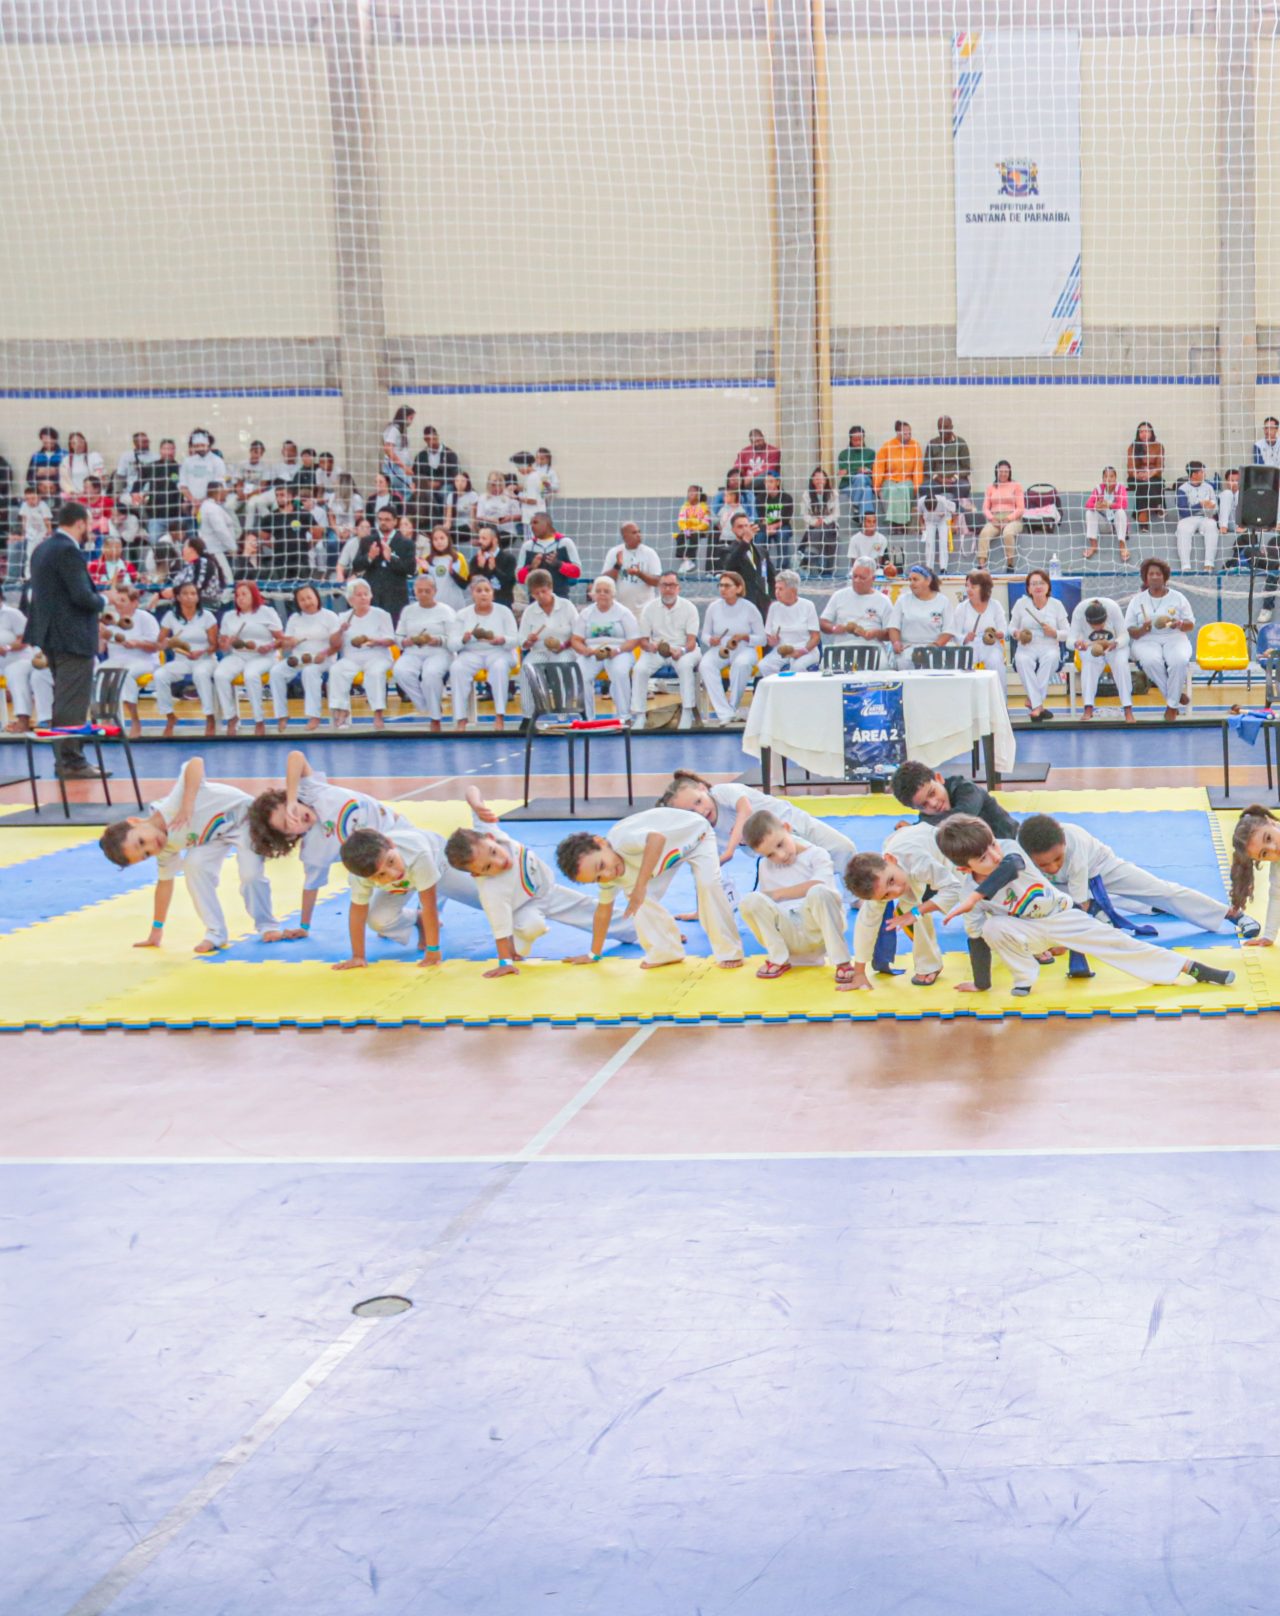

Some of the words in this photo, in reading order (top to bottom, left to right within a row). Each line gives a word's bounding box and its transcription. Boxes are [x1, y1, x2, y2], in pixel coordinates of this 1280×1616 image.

[989, 203, 1034, 211] PREFEITURA
[1036, 203, 1046, 211] DE
[965, 213, 1007, 223] SANTANA
[1009, 212, 1022, 222] DE
[1024, 211, 1071, 222] PARNAÍBA
[852, 728, 889, 743] ÁREA
[890, 728, 899, 741] 2
